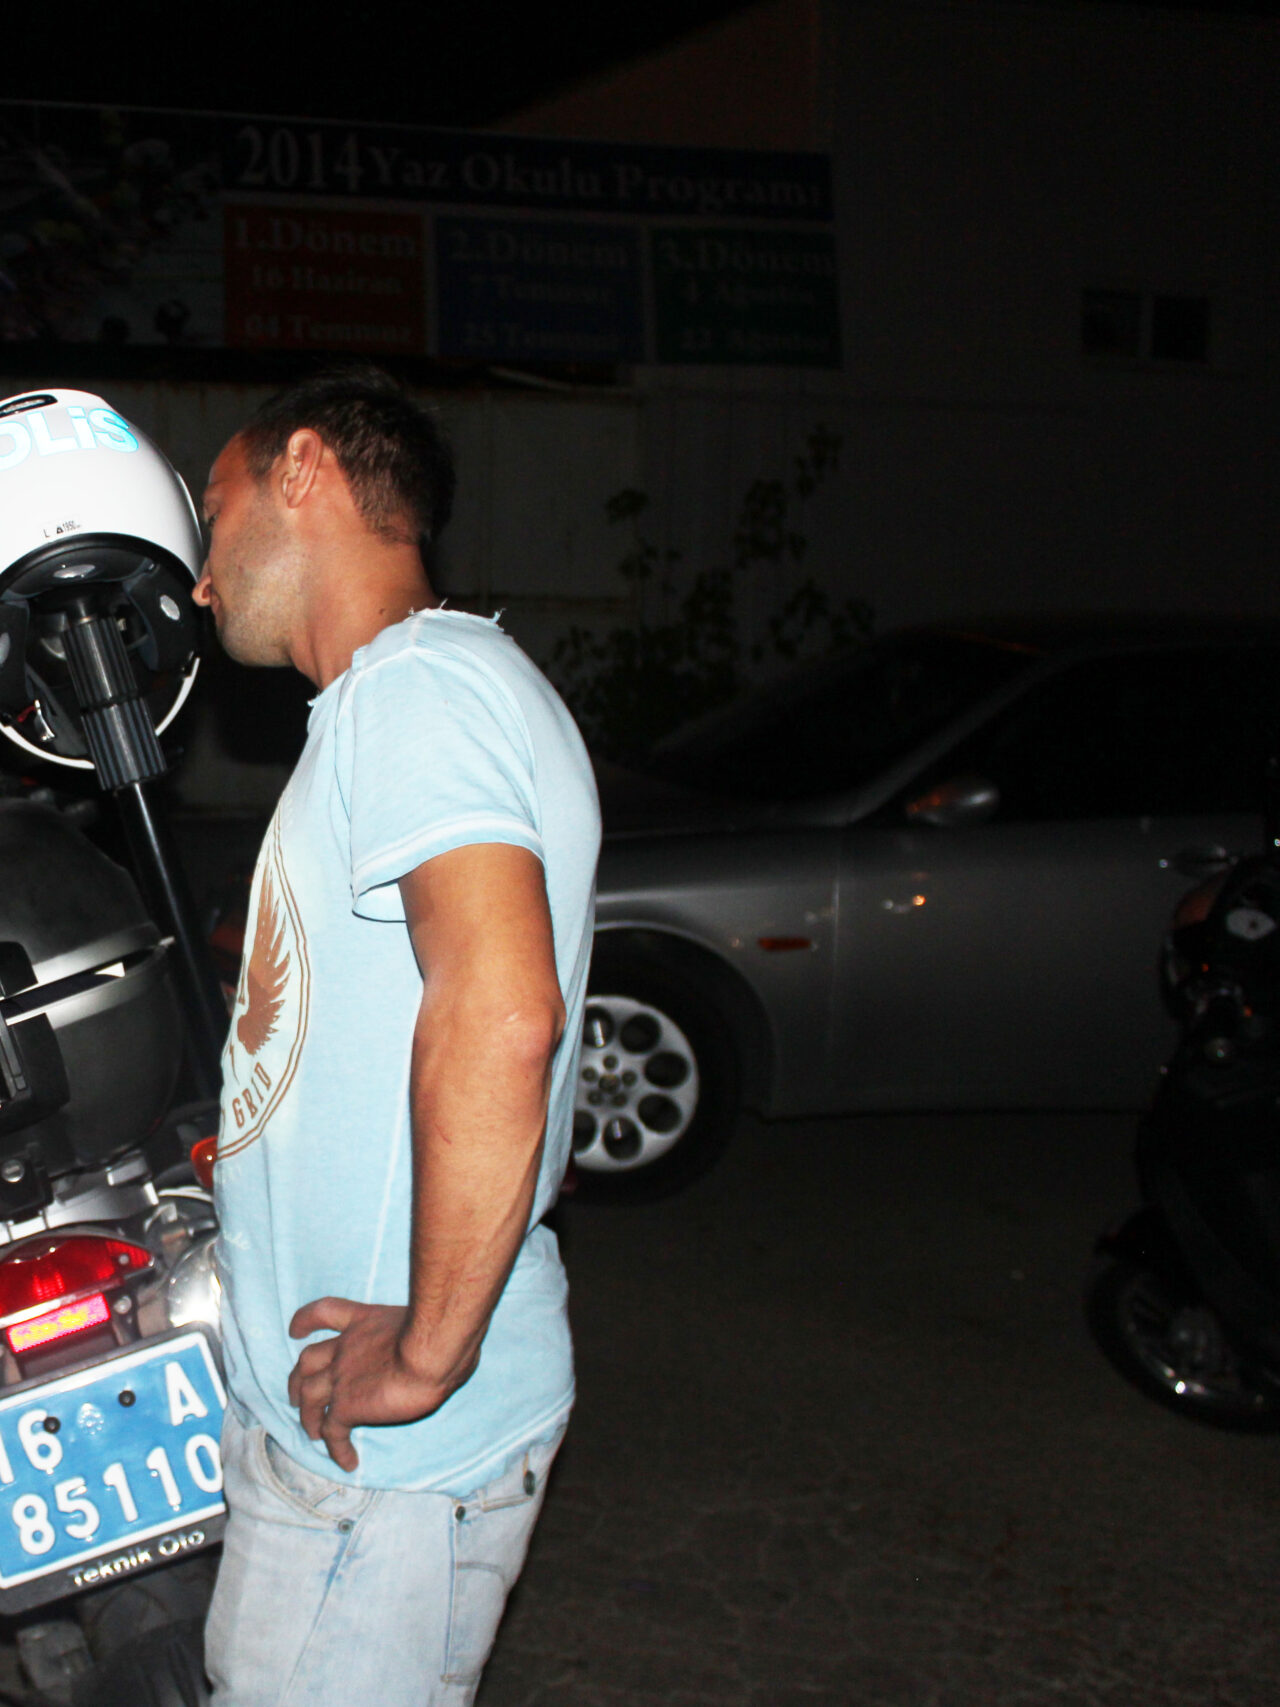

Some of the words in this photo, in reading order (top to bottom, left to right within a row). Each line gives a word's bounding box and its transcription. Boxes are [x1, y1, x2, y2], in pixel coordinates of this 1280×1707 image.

[236, 124, 363, 193] 2014
[367, 145, 450, 189] Yaz
[460, 151, 602, 199] Okulu
[234, 216, 417, 258] 1.Dönem
[164, 1361, 209, 1427] A
[11, 1433, 224, 1556] 85110
[69, 1549, 154, 1587] Teknik
